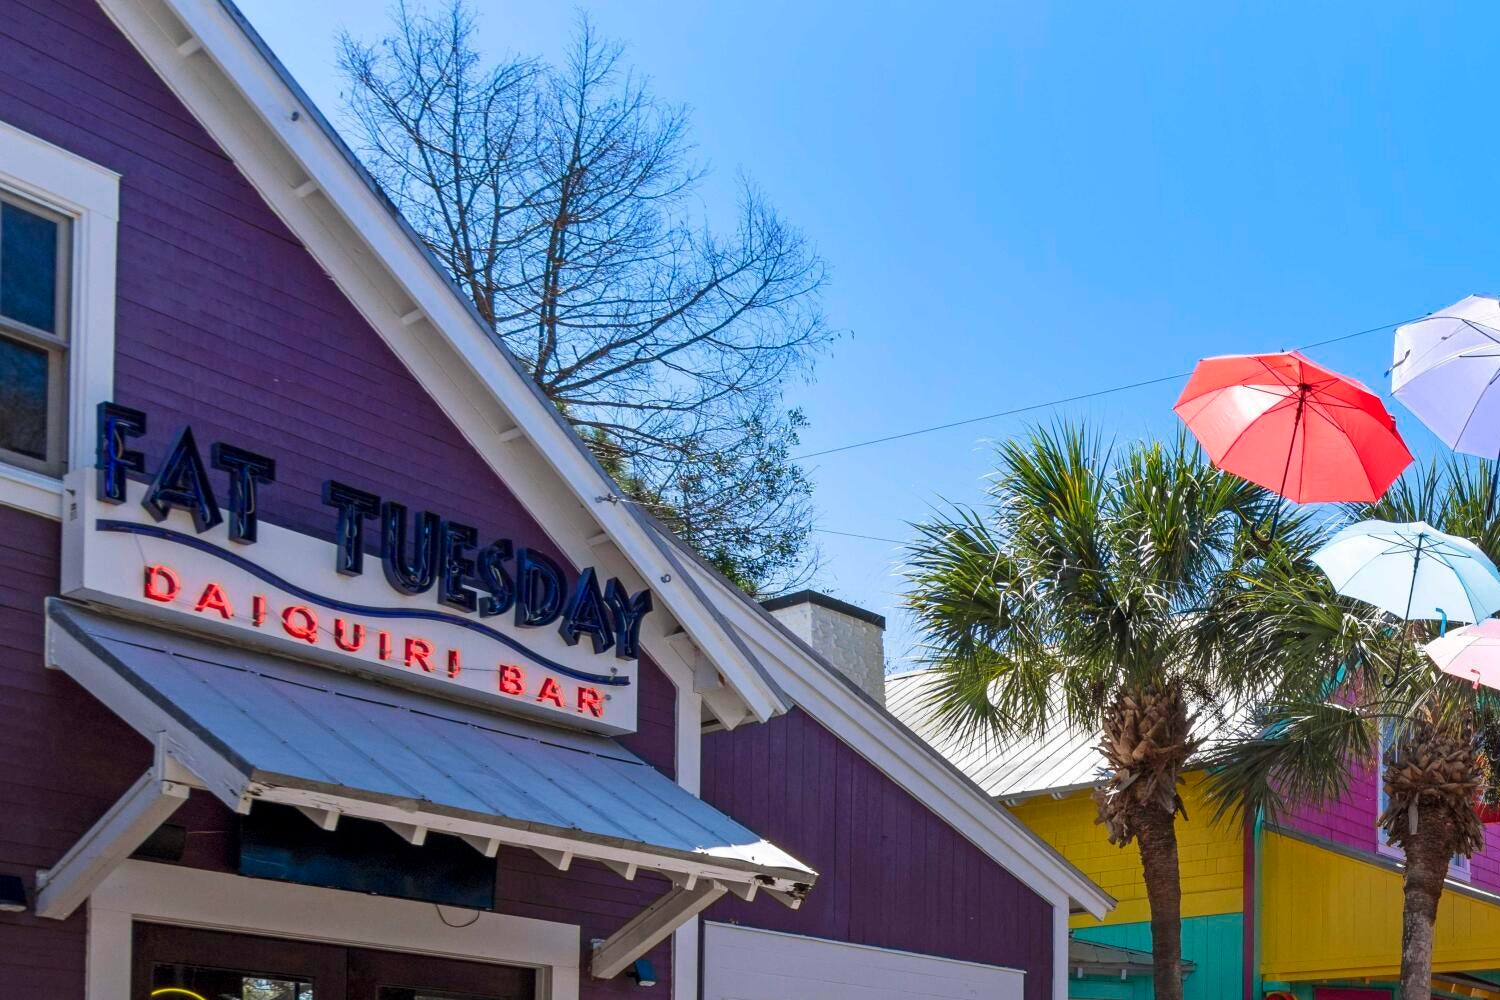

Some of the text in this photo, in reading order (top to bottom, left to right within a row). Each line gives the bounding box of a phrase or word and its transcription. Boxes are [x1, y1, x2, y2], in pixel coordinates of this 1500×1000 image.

[96, 401, 653, 661] FAT TUESDAY
[144, 564, 607, 718] DAIQUIRI BAR
